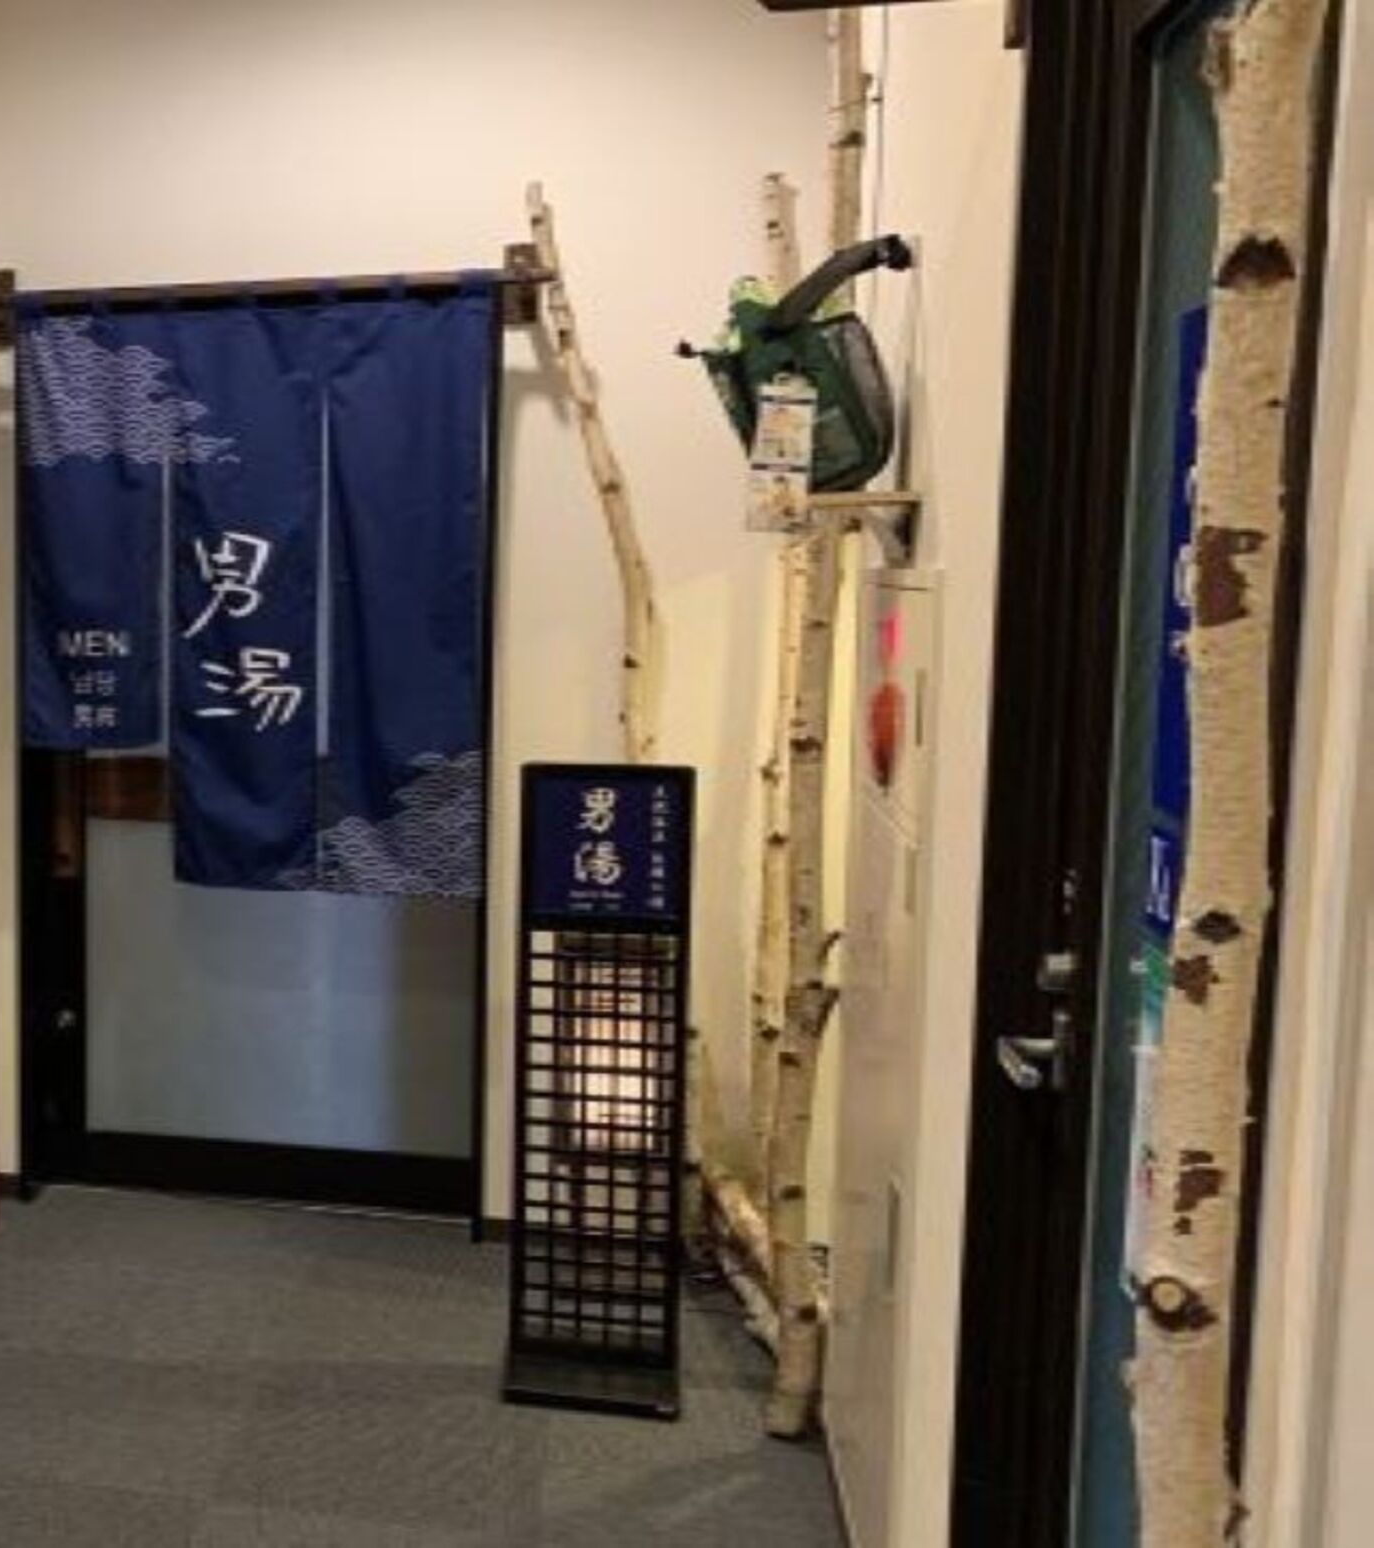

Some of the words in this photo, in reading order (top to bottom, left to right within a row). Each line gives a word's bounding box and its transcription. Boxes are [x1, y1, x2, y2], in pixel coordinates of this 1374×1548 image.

[58, 631, 130, 656] MEN
[183, 531, 303, 731] 男湯
[575, 787, 622, 885] 男湯
